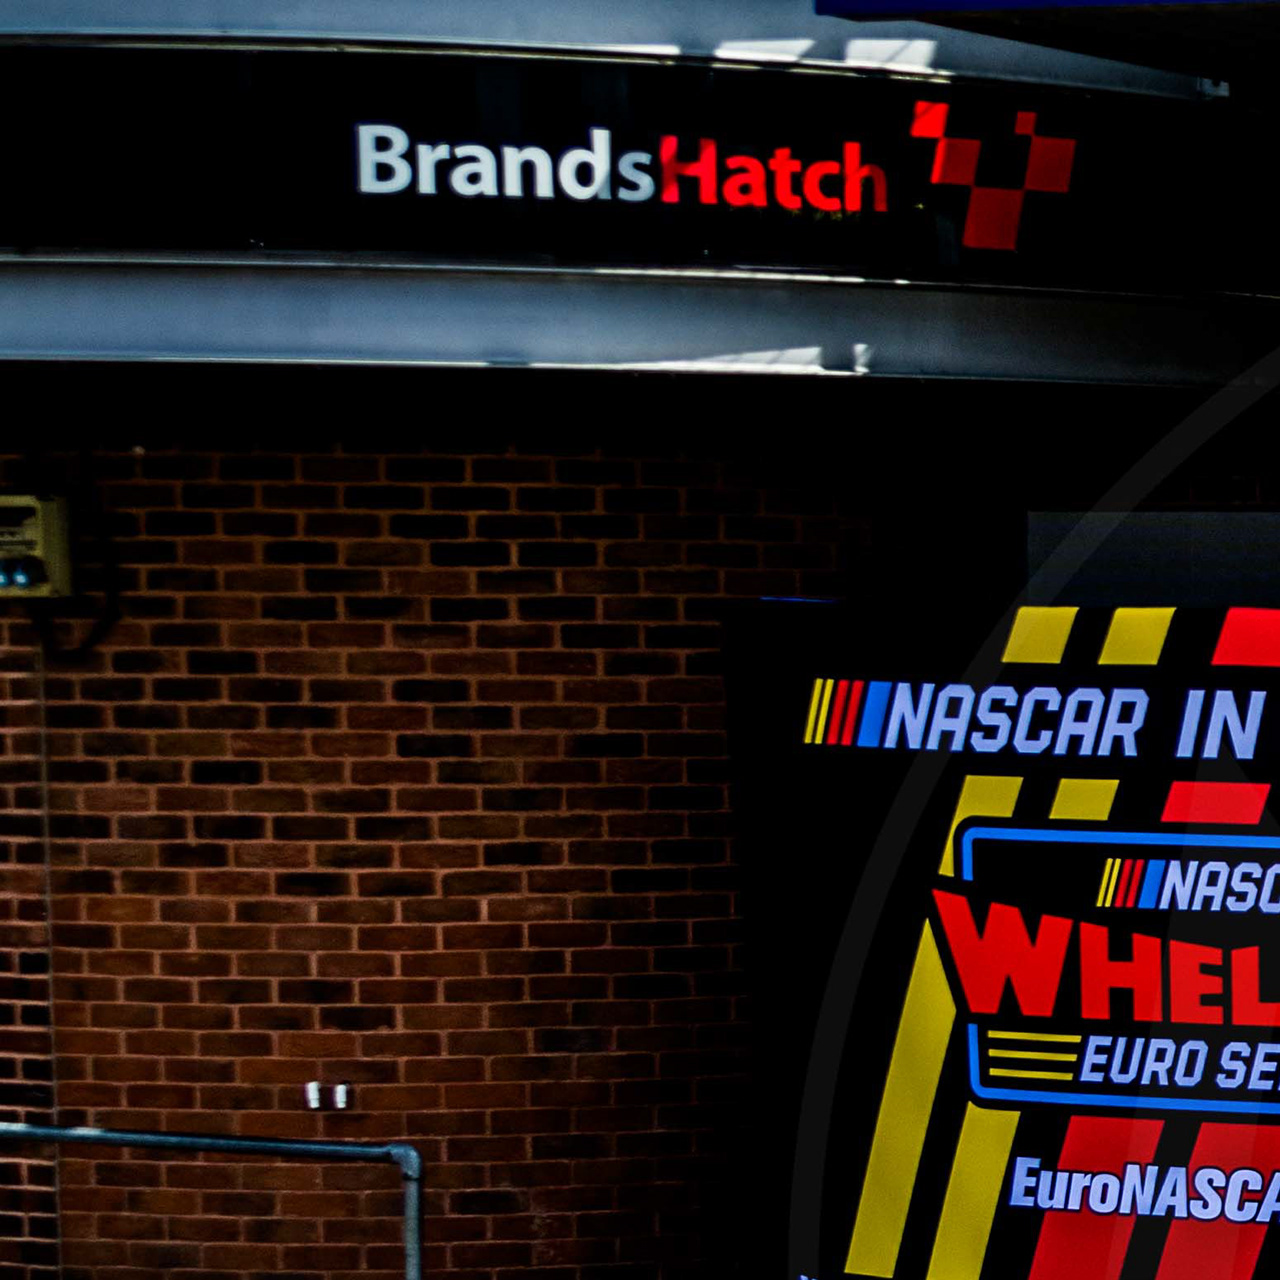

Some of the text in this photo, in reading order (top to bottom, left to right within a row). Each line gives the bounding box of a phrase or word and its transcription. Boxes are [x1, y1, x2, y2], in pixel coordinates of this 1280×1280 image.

[884, 682, 1150, 757] NASCAR
[1175, 689, 1268, 761] IN
[1079, 1036, 1208, 1087] EURO
